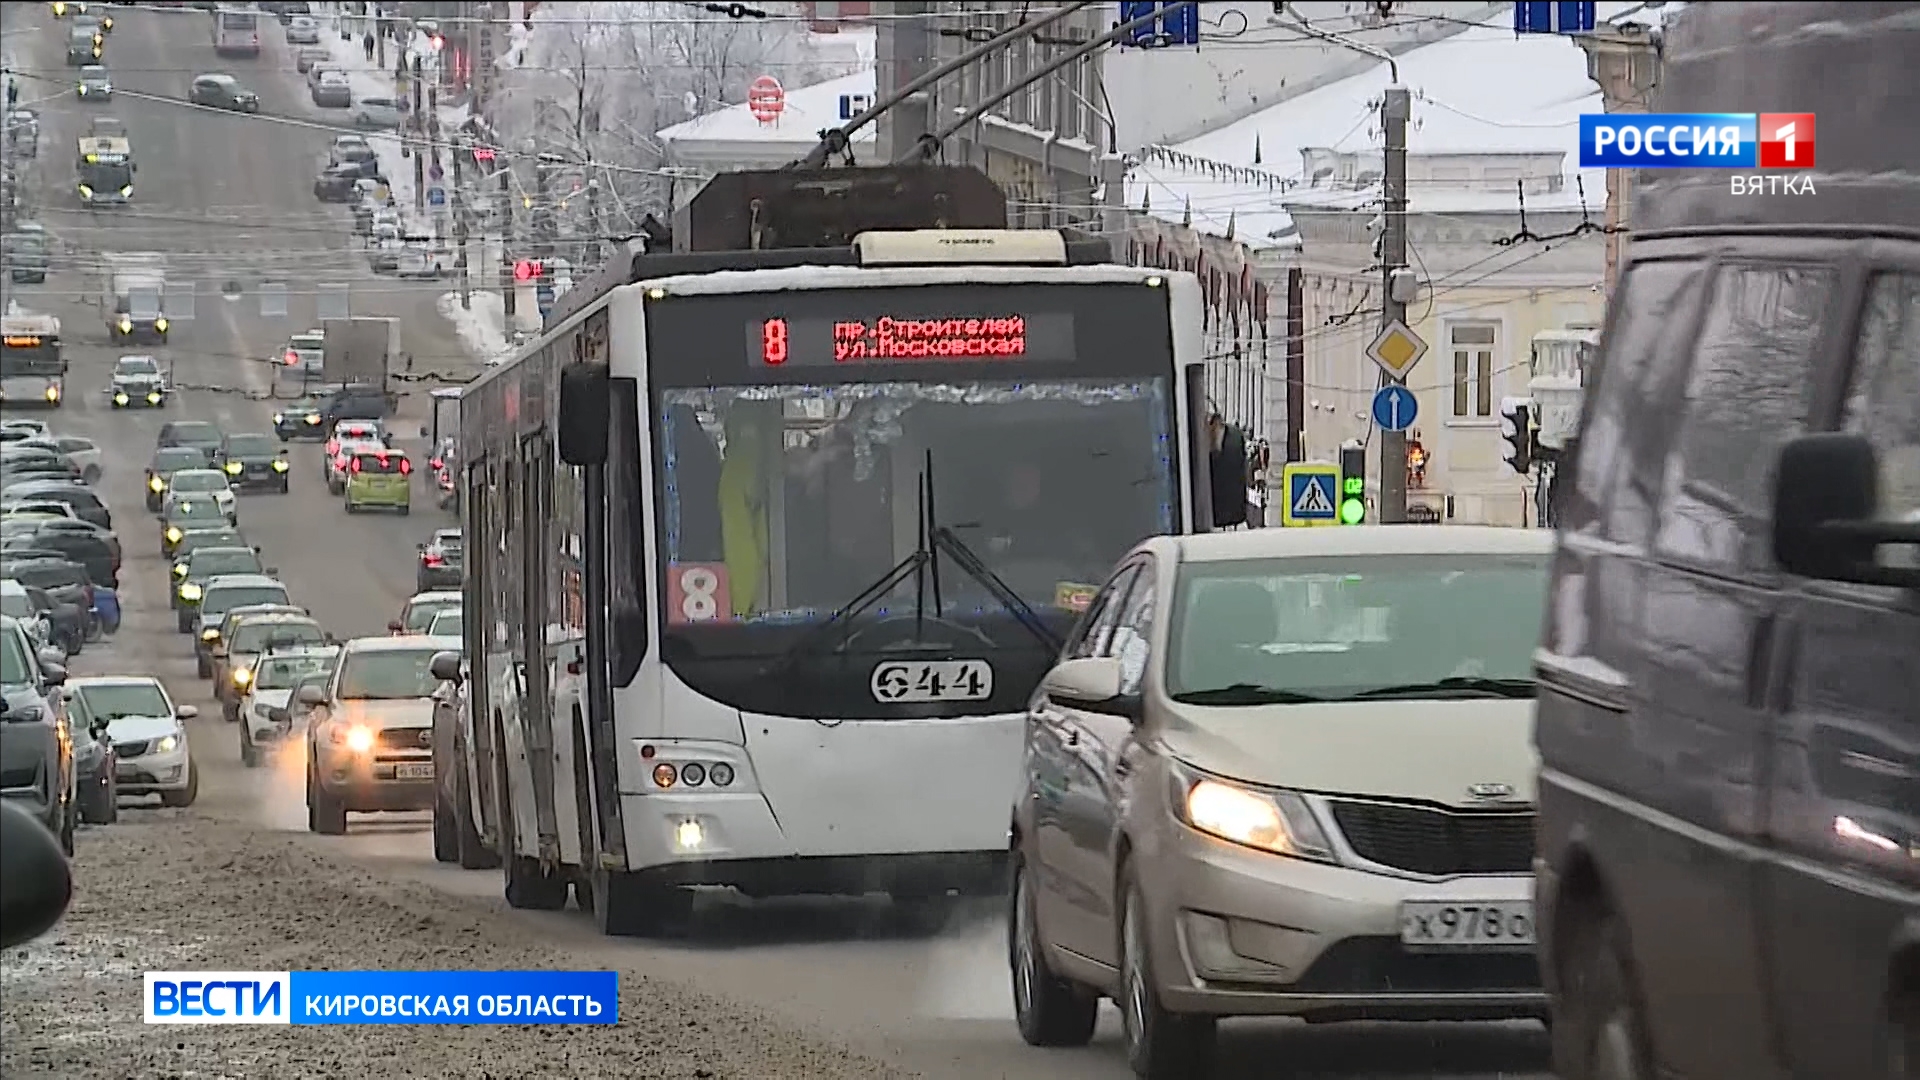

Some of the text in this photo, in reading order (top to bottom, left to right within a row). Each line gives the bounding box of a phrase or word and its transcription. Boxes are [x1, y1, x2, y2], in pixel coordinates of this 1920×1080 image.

[764, 318, 787, 363] 8
[680, 567, 719, 620] 8
[877, 665, 985, 698] 644
